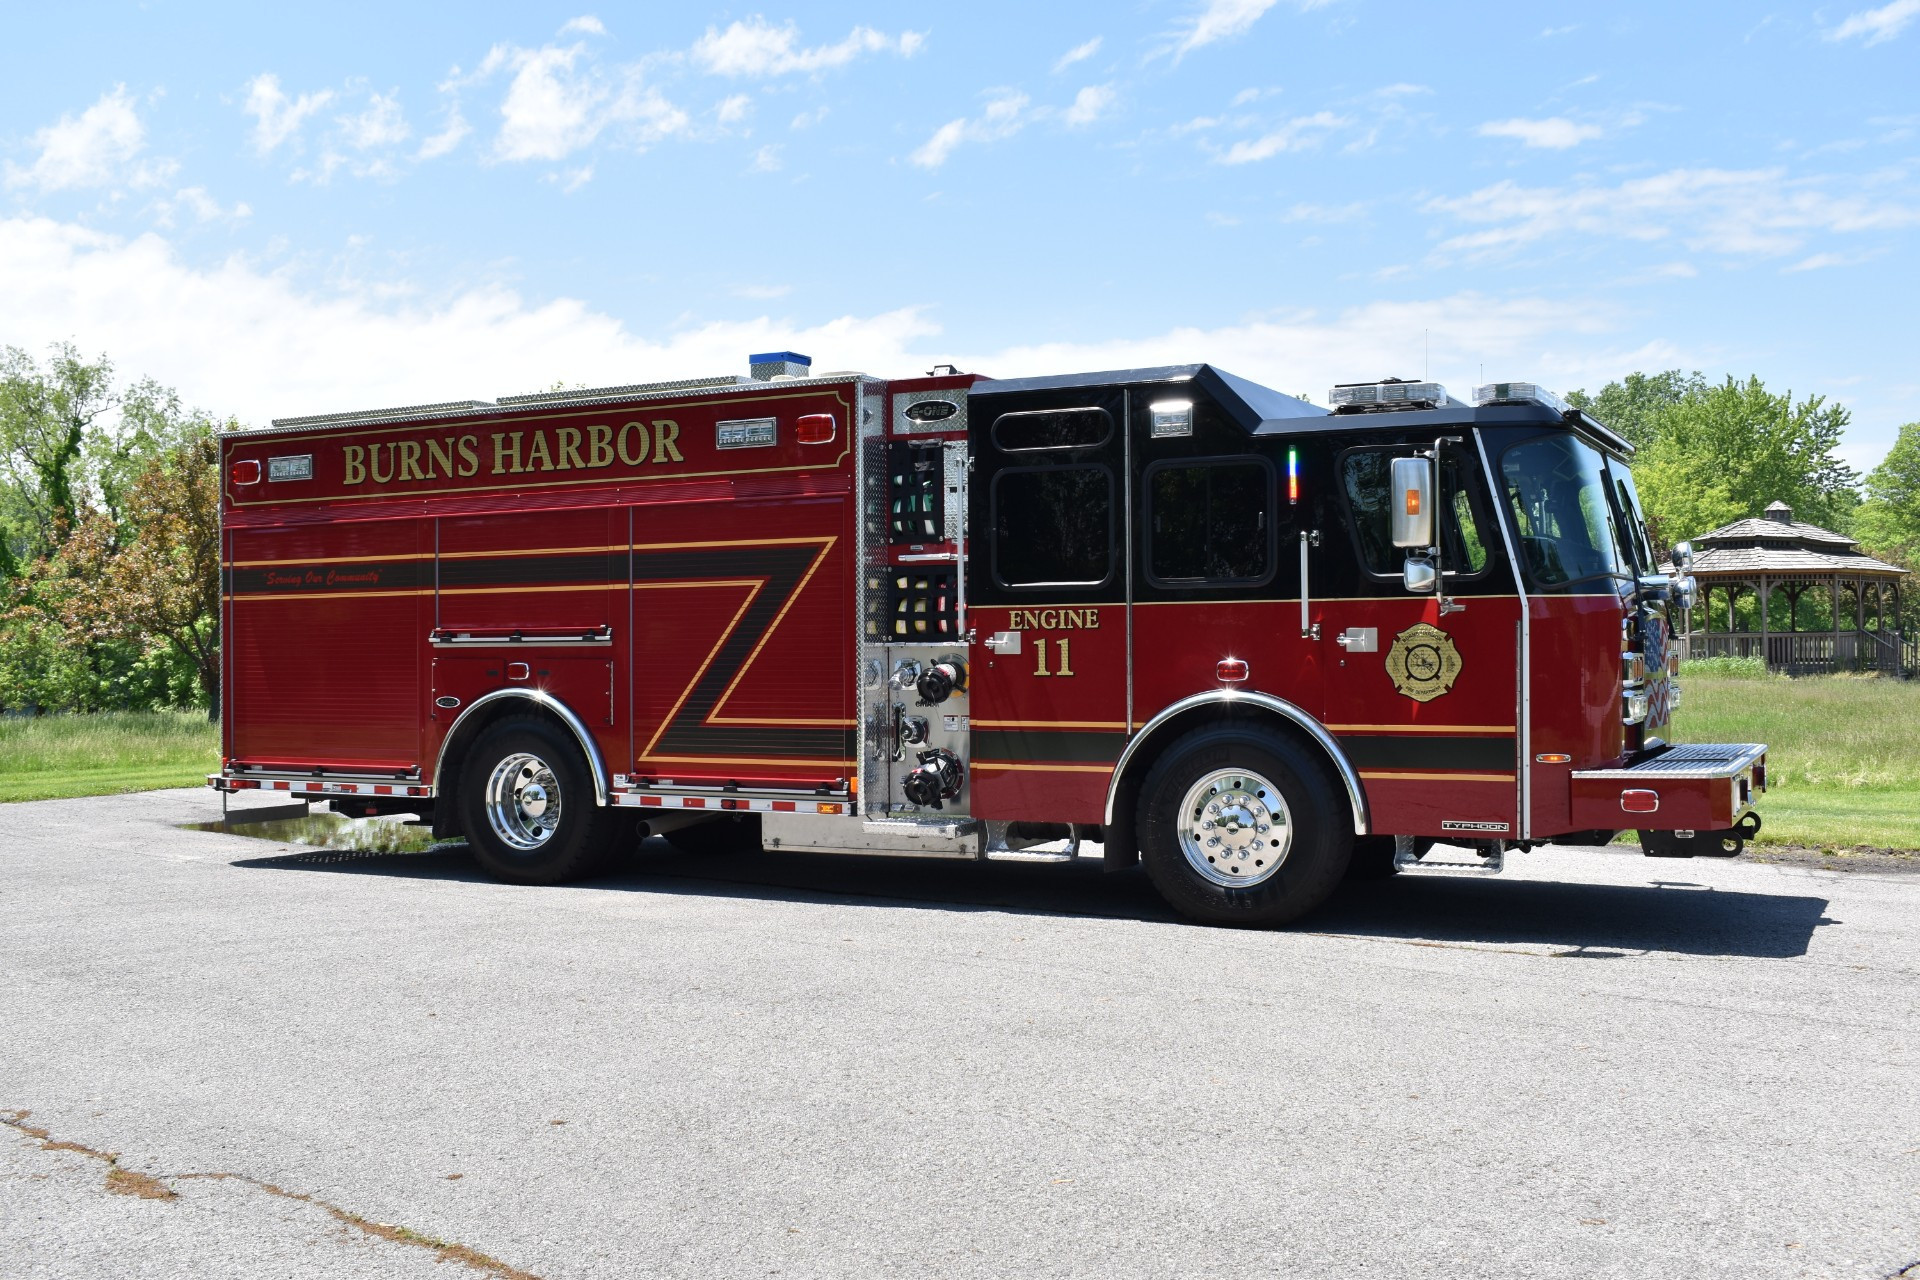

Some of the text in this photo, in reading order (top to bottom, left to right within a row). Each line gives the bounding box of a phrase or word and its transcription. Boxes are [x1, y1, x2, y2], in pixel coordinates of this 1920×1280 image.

[911, 404, 949, 417] E-ONE
[343, 419, 684, 485] BURNS HARBOR
[305, 571, 323, 584] Our
[1009, 609, 1099, 630] ENGINE
[1033, 638, 1074, 676] 11
[1443, 822, 1507, 830] TYPHOON
